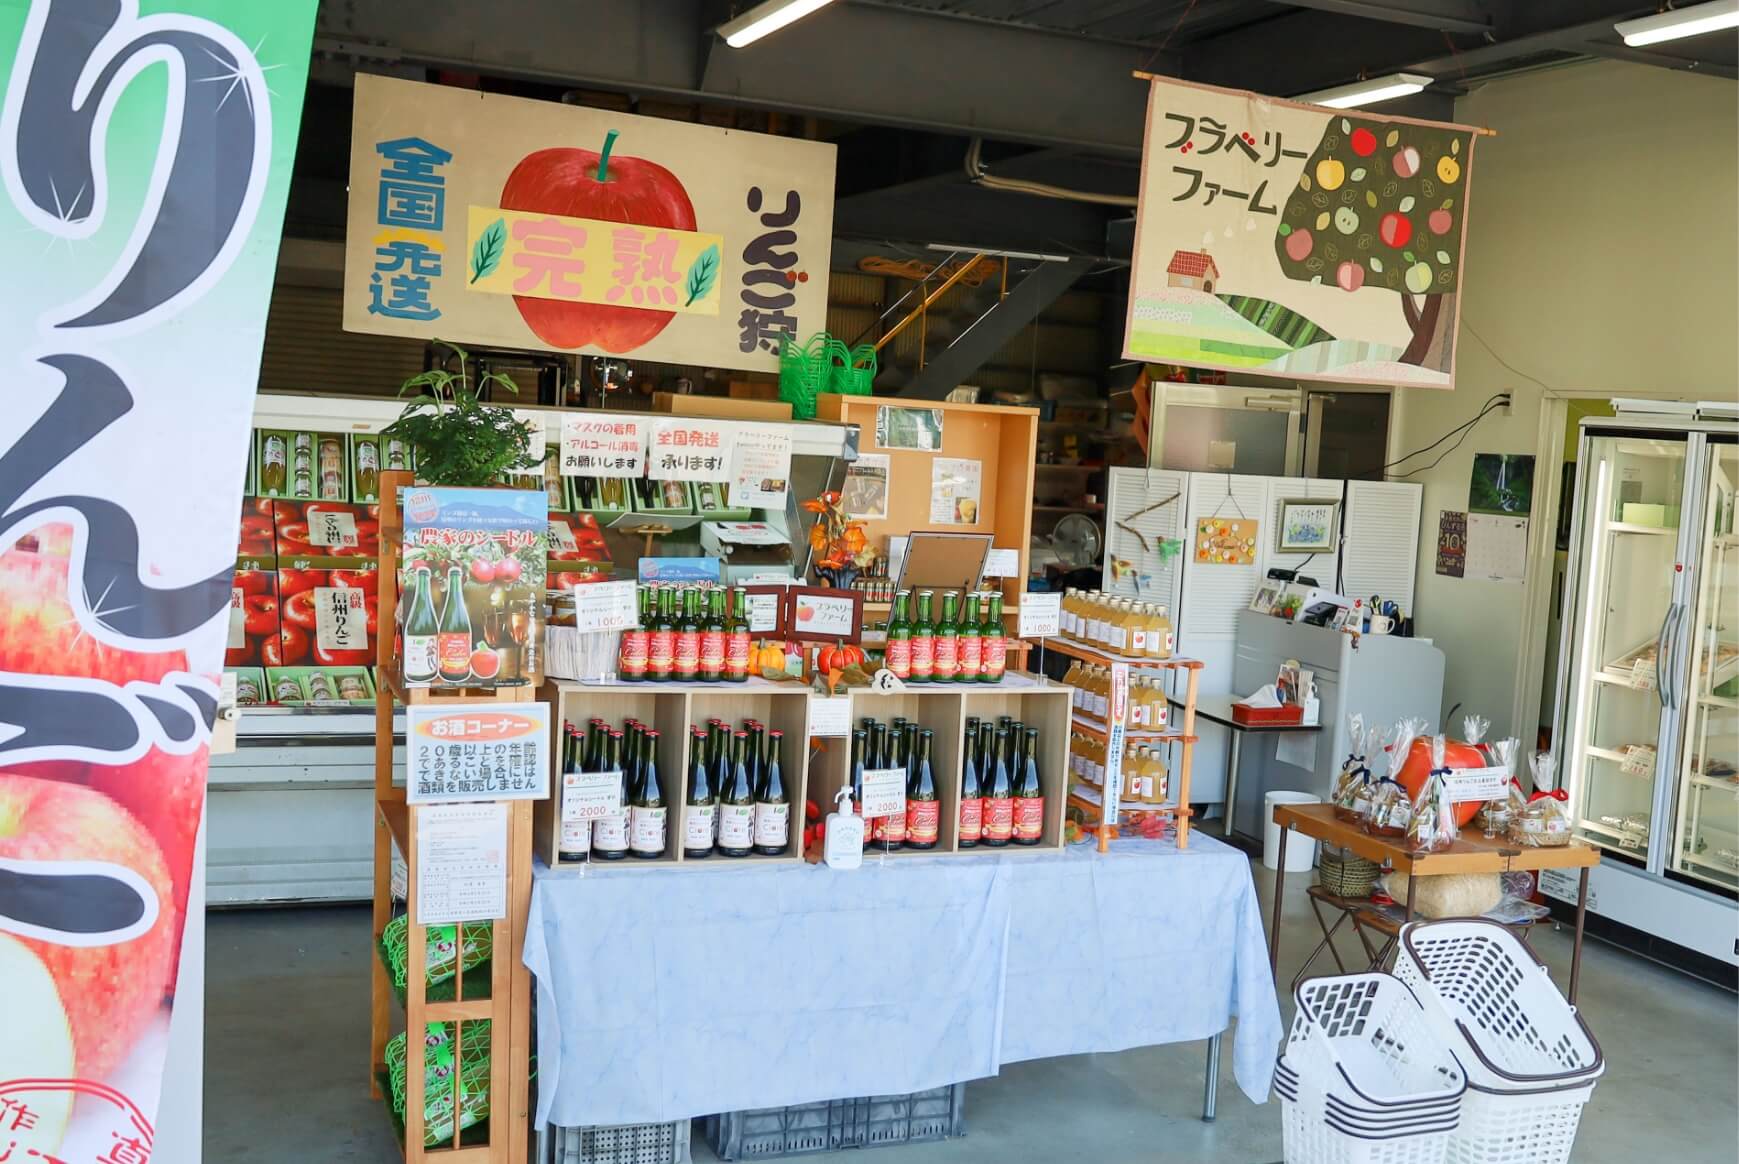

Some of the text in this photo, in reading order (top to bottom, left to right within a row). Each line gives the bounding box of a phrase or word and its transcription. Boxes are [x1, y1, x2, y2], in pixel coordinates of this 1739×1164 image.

[1172, 165, 1278, 216] ファーム
[368, 137, 453, 321] 全国発送
[511, 217, 681, 306] 完熟
[657, 430, 720, 448] 全国発送
[566, 455, 638, 470] お願いします
[420, 528, 537, 548] 農家のシードル
[331, 592, 351, 645] 信州りんご
[431, 718, 530, 736] お酒コーナー
[418, 767, 536, 782] できない場合には
[417, 778, 536, 795] 酒類を販売しません
[580, 806, 606, 817] 2000
